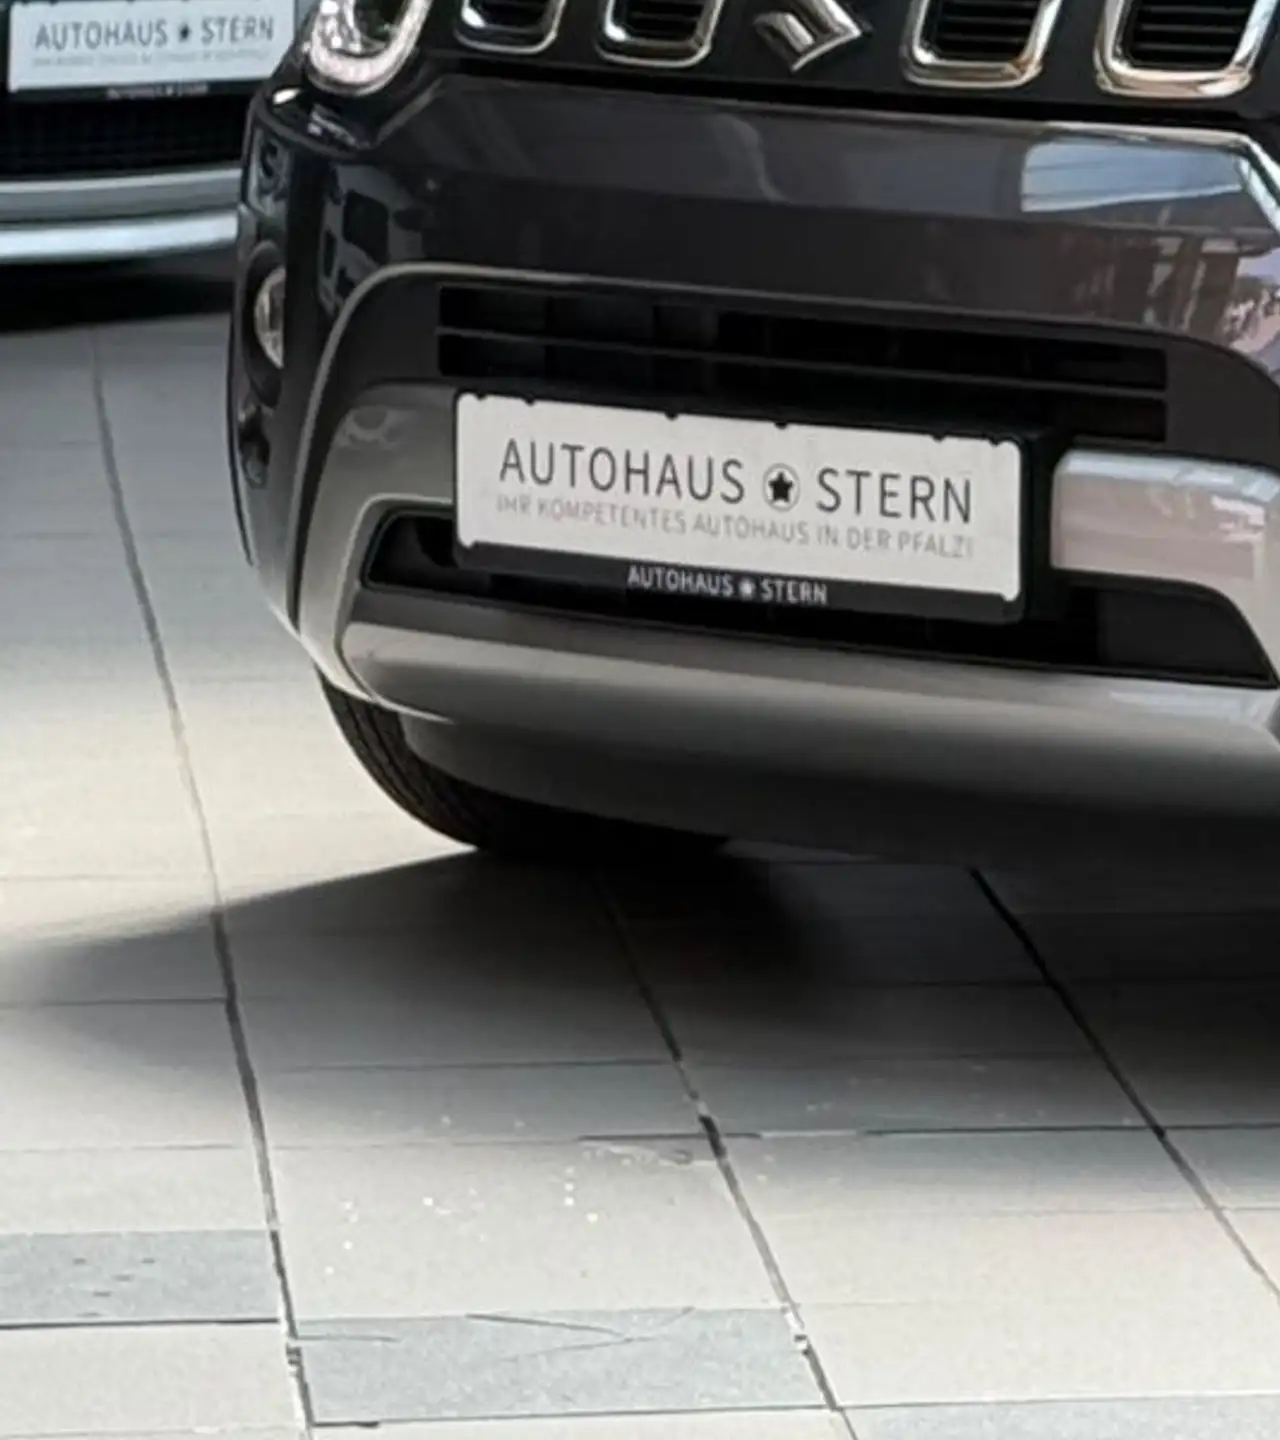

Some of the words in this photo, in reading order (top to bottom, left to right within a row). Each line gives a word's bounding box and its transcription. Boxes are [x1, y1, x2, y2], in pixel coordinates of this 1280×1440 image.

[34, 20, 168, 50] AUTOHAUS
[200, 16, 274, 43] STERN
[499, 437, 745, 505] AUTOHAUS
[816, 466, 971, 524] STERN
[496, 493, 531, 515] IHR
[536, 496, 688, 536] KOMPETENTES
[692, 513, 809, 545] AUTOHAUS
[816, 523, 840, 546] IN
[846, 526, 893, 552] DER
[627, 564, 734, 595] AUTOHAUS
[760, 577, 828, 605] STERN
